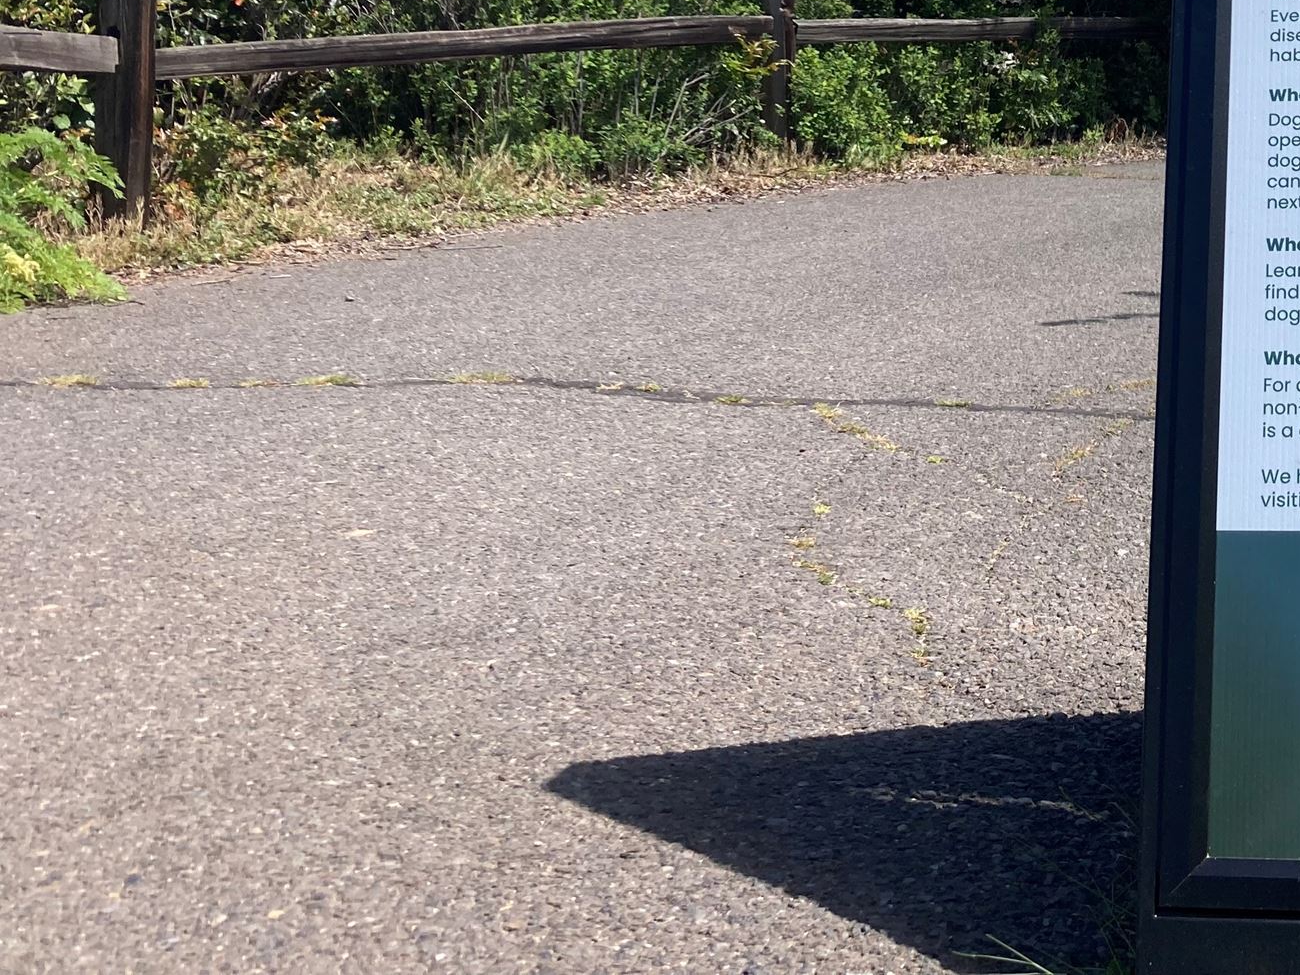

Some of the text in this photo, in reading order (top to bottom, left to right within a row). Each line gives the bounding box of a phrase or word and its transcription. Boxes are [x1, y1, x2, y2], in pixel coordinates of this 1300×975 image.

[1266, 175, 1300, 188] can
[1264, 305, 1300, 326] dog
[1262, 422, 1277, 439] is
[1281, 426, 1294, 439] a
[1260, 469, 1292, 485] We
